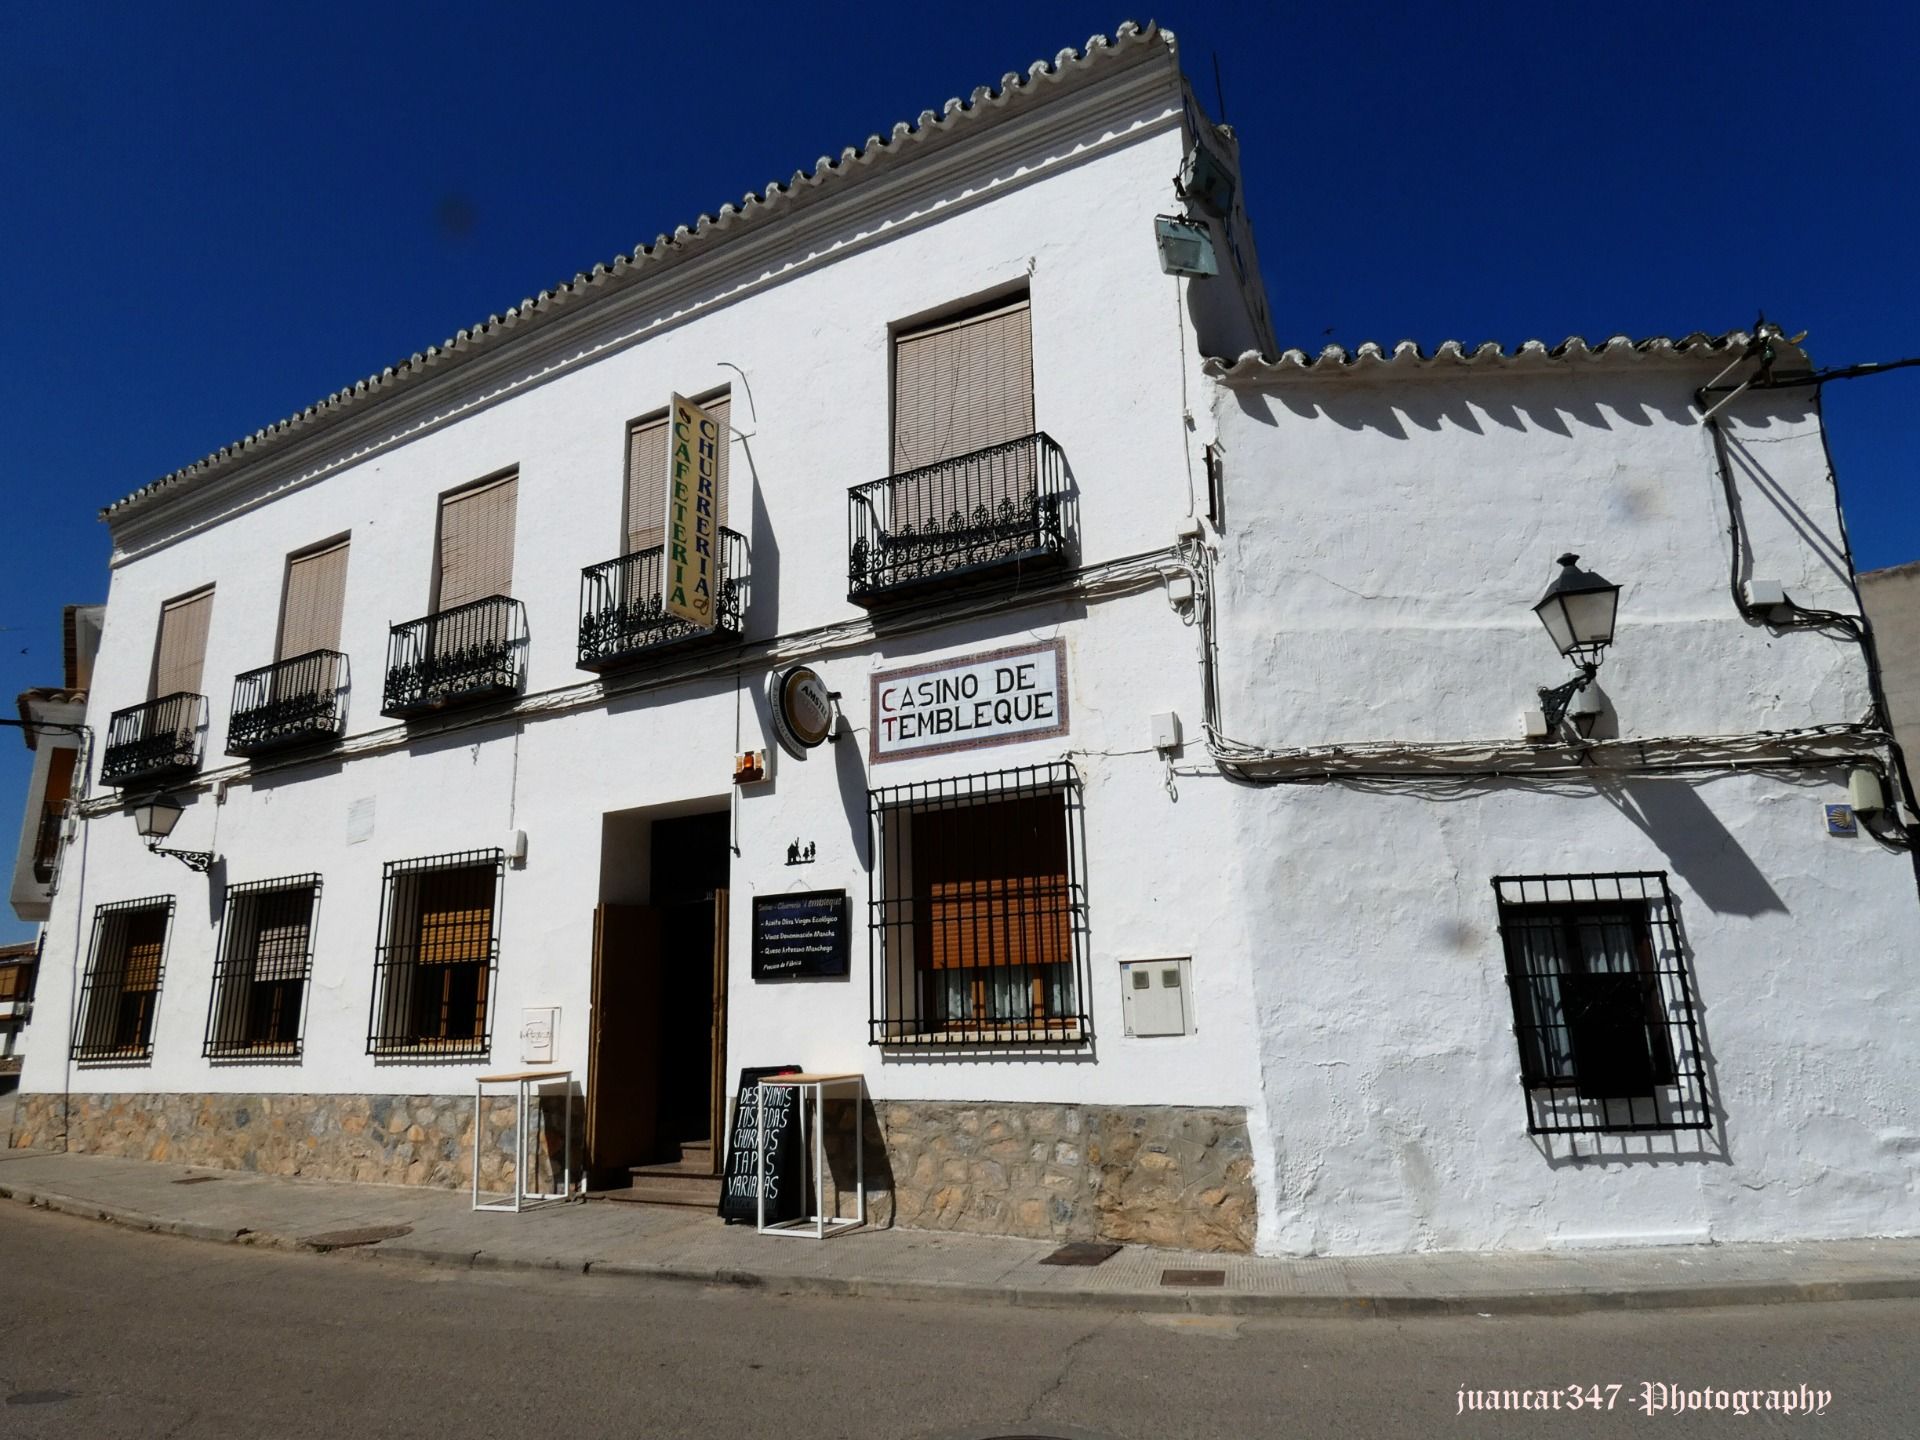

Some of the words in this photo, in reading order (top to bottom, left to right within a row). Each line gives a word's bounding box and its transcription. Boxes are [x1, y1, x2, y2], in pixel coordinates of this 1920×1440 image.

[671, 422, 692, 608] CAFETERIA
[694, 420, 715, 600] CHURRERIA
[882, 673, 979, 713] CASINO
[995, 663, 1036, 695] DE
[882, 691, 1053, 741] TEMBLEQUE
[740, 1086, 792, 1107] DESYUNOS
[728, 1175, 779, 1199] VARIAAS
[732, 1151, 776, 1175] TAPS
